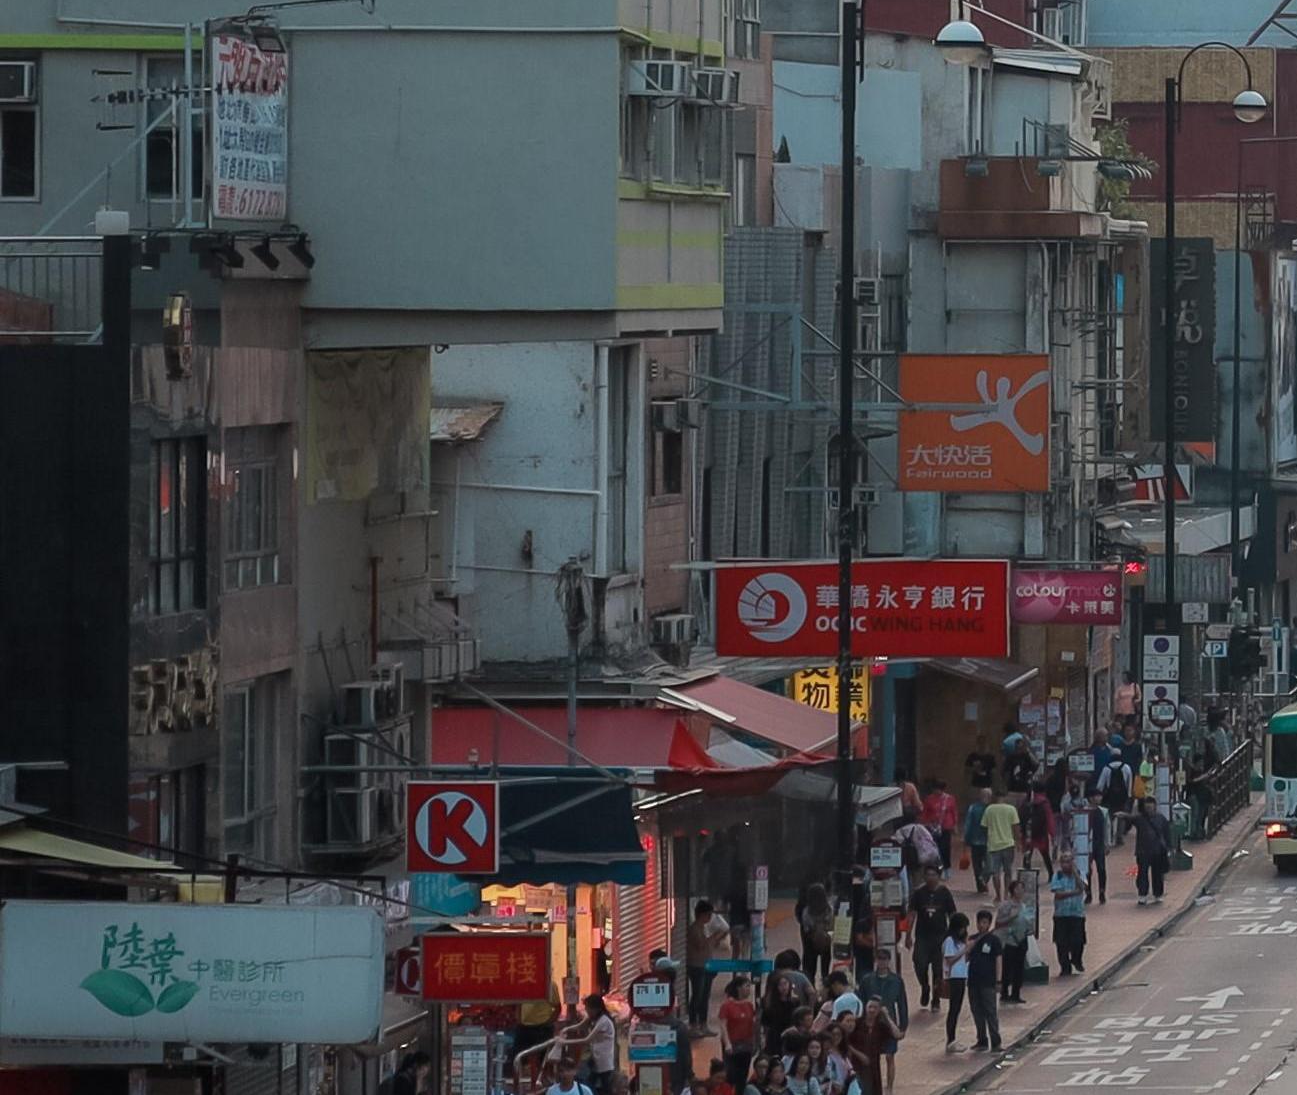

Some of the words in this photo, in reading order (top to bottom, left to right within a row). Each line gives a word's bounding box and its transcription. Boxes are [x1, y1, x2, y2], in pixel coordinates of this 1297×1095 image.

[907, 444, 992, 466] 大快活
[906, 468, 993, 479] Fairwood
[816, 616, 867, 632] OCC
[872, 617, 924, 632] WING
[929, 617, 985, 632] HANG
[189, 959, 290, 983] 中醫診所
[211, 985, 306, 1006] Evergreen
[1094, 1014, 1238, 1029] BUS
[1069, 1028, 1241, 1045] STOP
[1039, 1044, 1218, 1066] 巴士
[1056, 1065, 1151, 1087] 站
